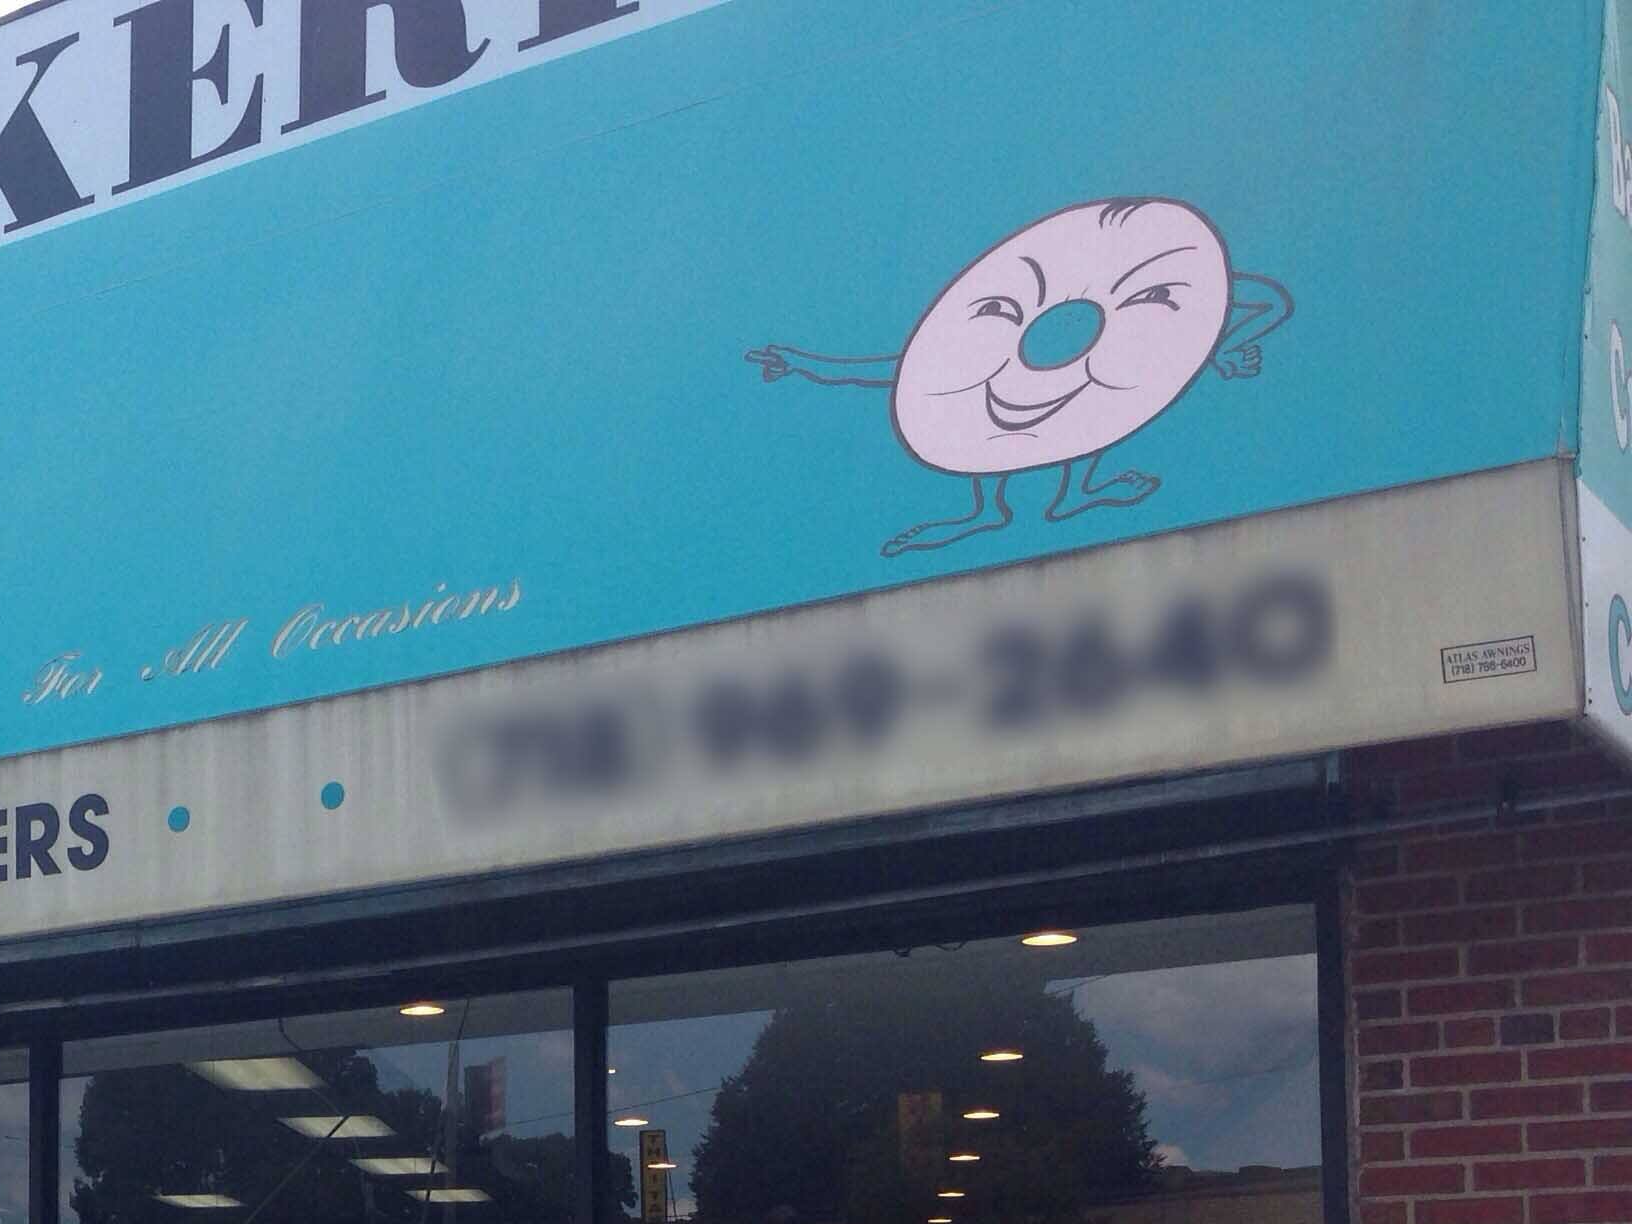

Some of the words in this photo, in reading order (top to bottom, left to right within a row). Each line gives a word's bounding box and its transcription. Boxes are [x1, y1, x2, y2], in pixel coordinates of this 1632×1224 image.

[23, 652, 105, 705] For
[140, 616, 250, 682] All
[270, 577, 523, 660] Occasions
[1447, 651, 1478, 664] ATLAS
[1482, 644, 1530, 659] AWNINGS
